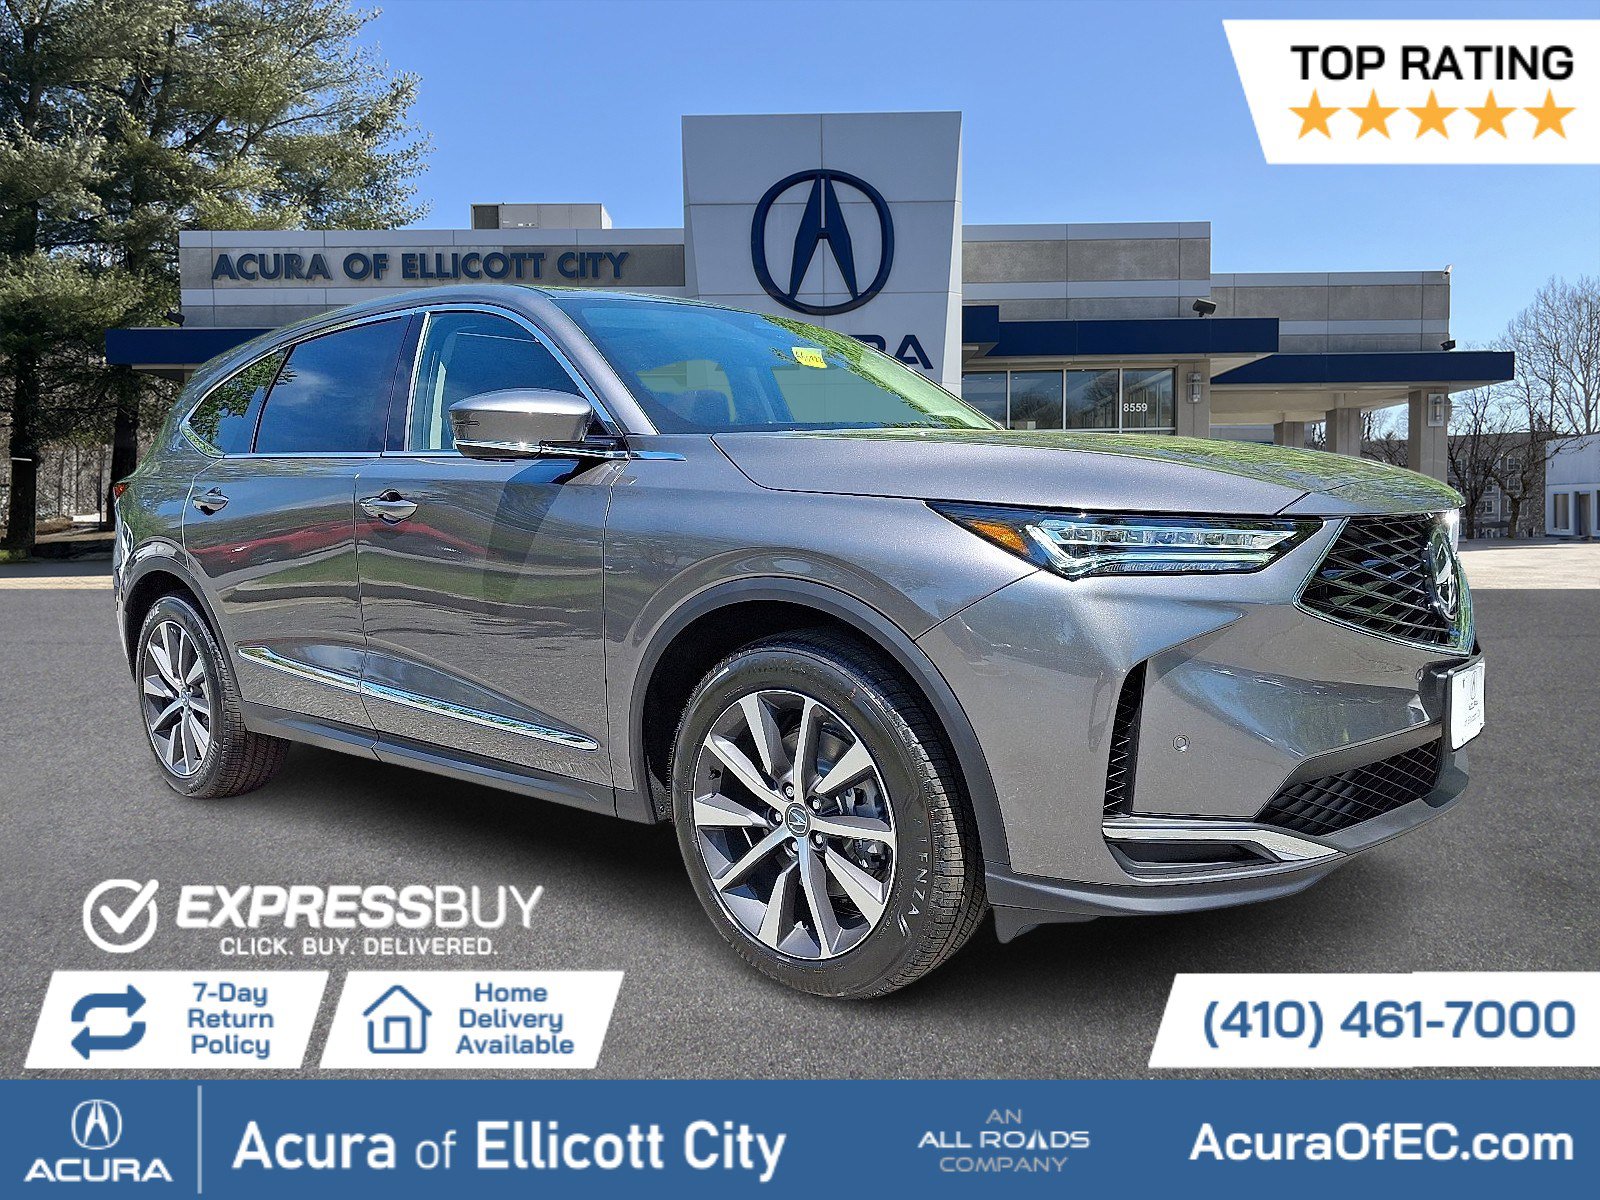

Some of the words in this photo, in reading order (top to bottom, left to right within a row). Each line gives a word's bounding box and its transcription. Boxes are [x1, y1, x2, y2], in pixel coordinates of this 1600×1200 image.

[211, 254, 331, 281] ACURA
[343, 253, 388, 280] OF
[402, 252, 546, 280] ELLICOTT
[557, 252, 630, 280] CITY
[1123, 402, 1148, 412] 8559
